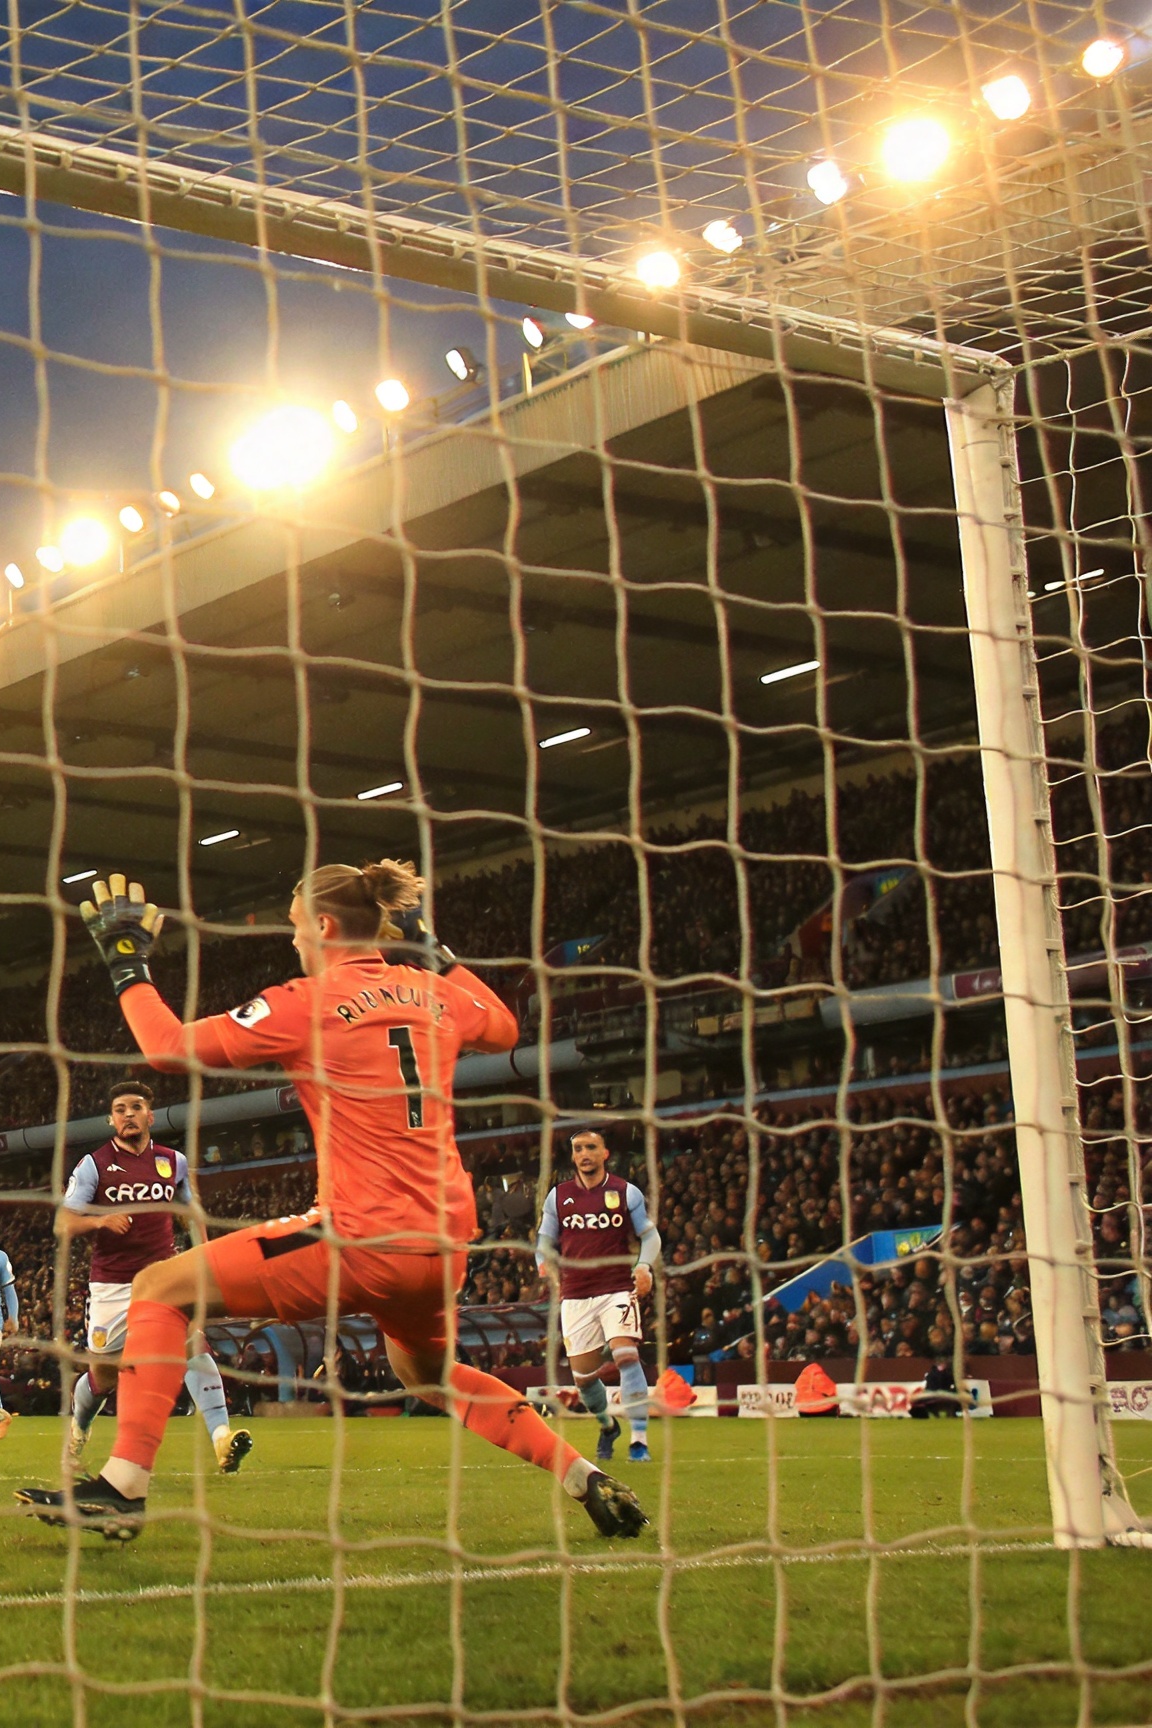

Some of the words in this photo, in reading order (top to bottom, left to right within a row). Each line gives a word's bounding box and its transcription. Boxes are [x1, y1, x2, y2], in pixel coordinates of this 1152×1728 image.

[387, 1025, 424, 1130] 1
[104, 1182, 176, 1203] CAZOO
[561, 1213, 624, 1230] CAZOO
